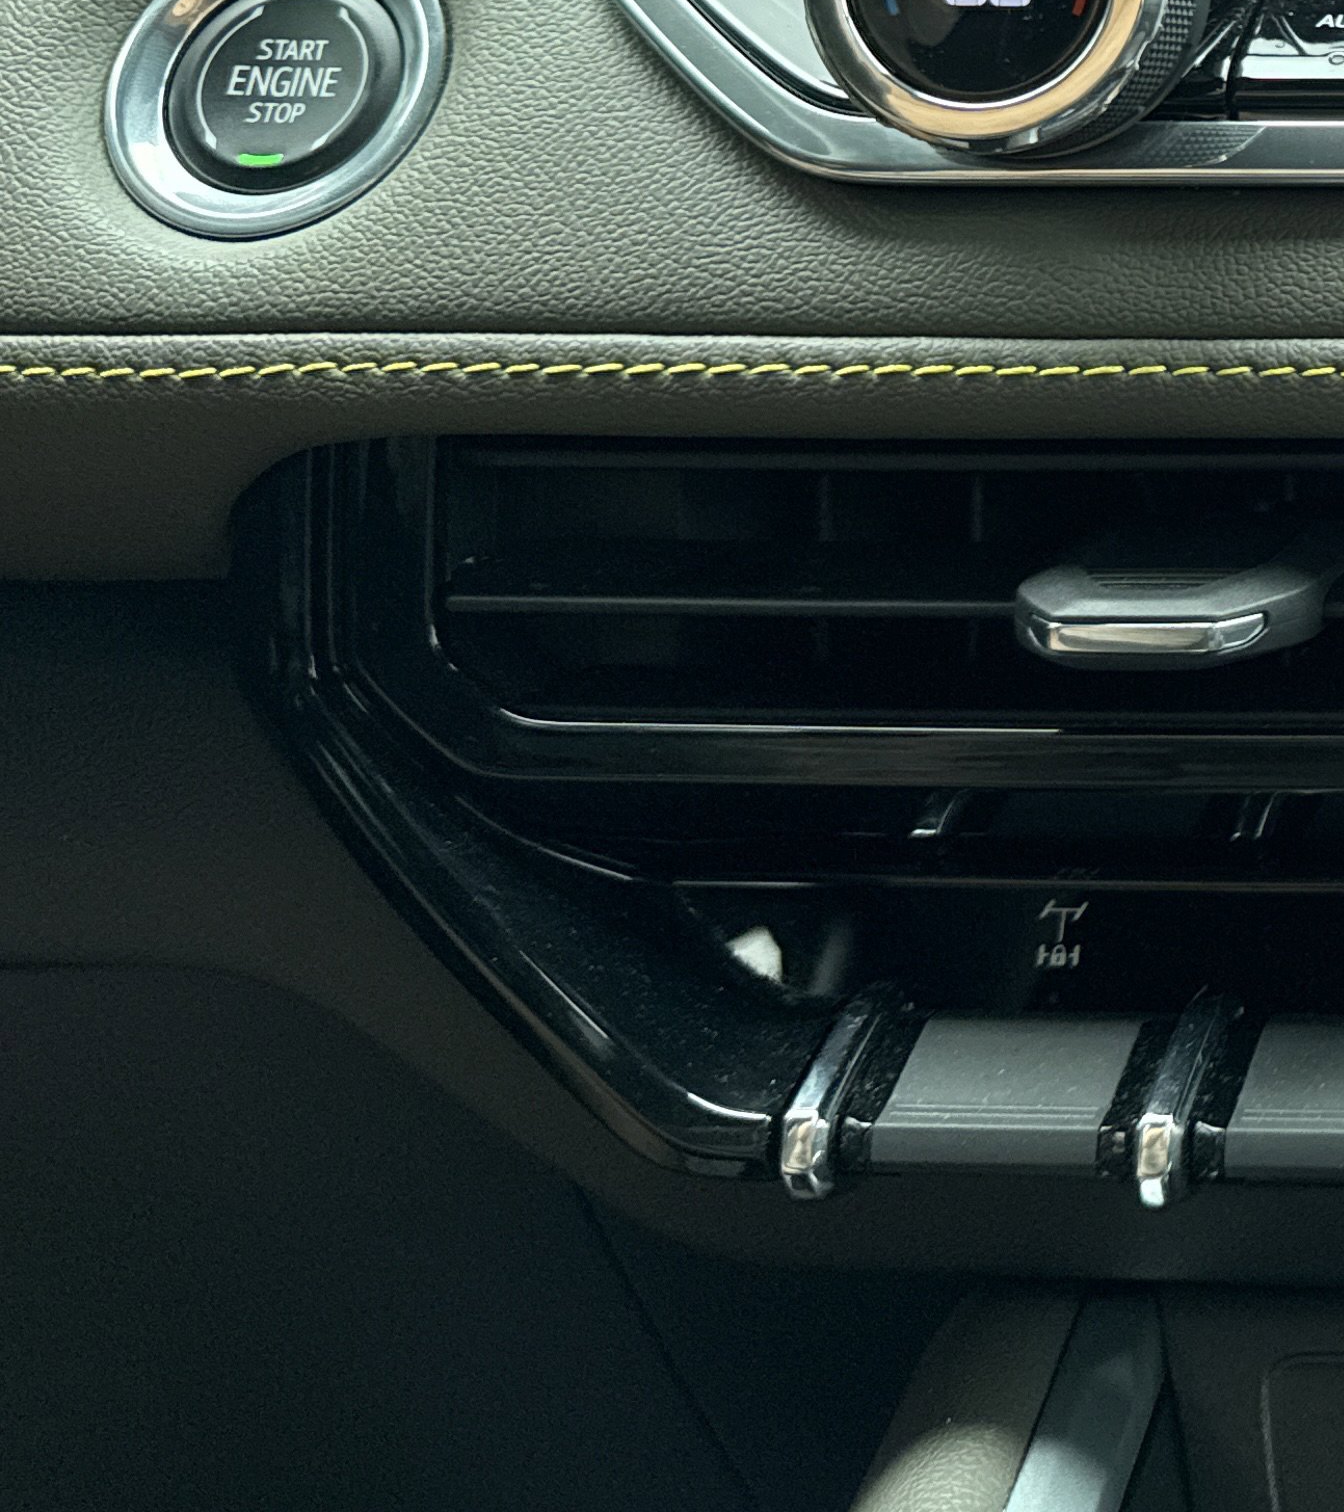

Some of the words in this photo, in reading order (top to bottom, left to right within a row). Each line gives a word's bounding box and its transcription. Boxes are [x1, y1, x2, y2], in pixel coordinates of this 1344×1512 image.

[256, 39, 328, 61] START
[226, 65, 342, 97] ENGINE
[245, 102, 306, 123] STOP
